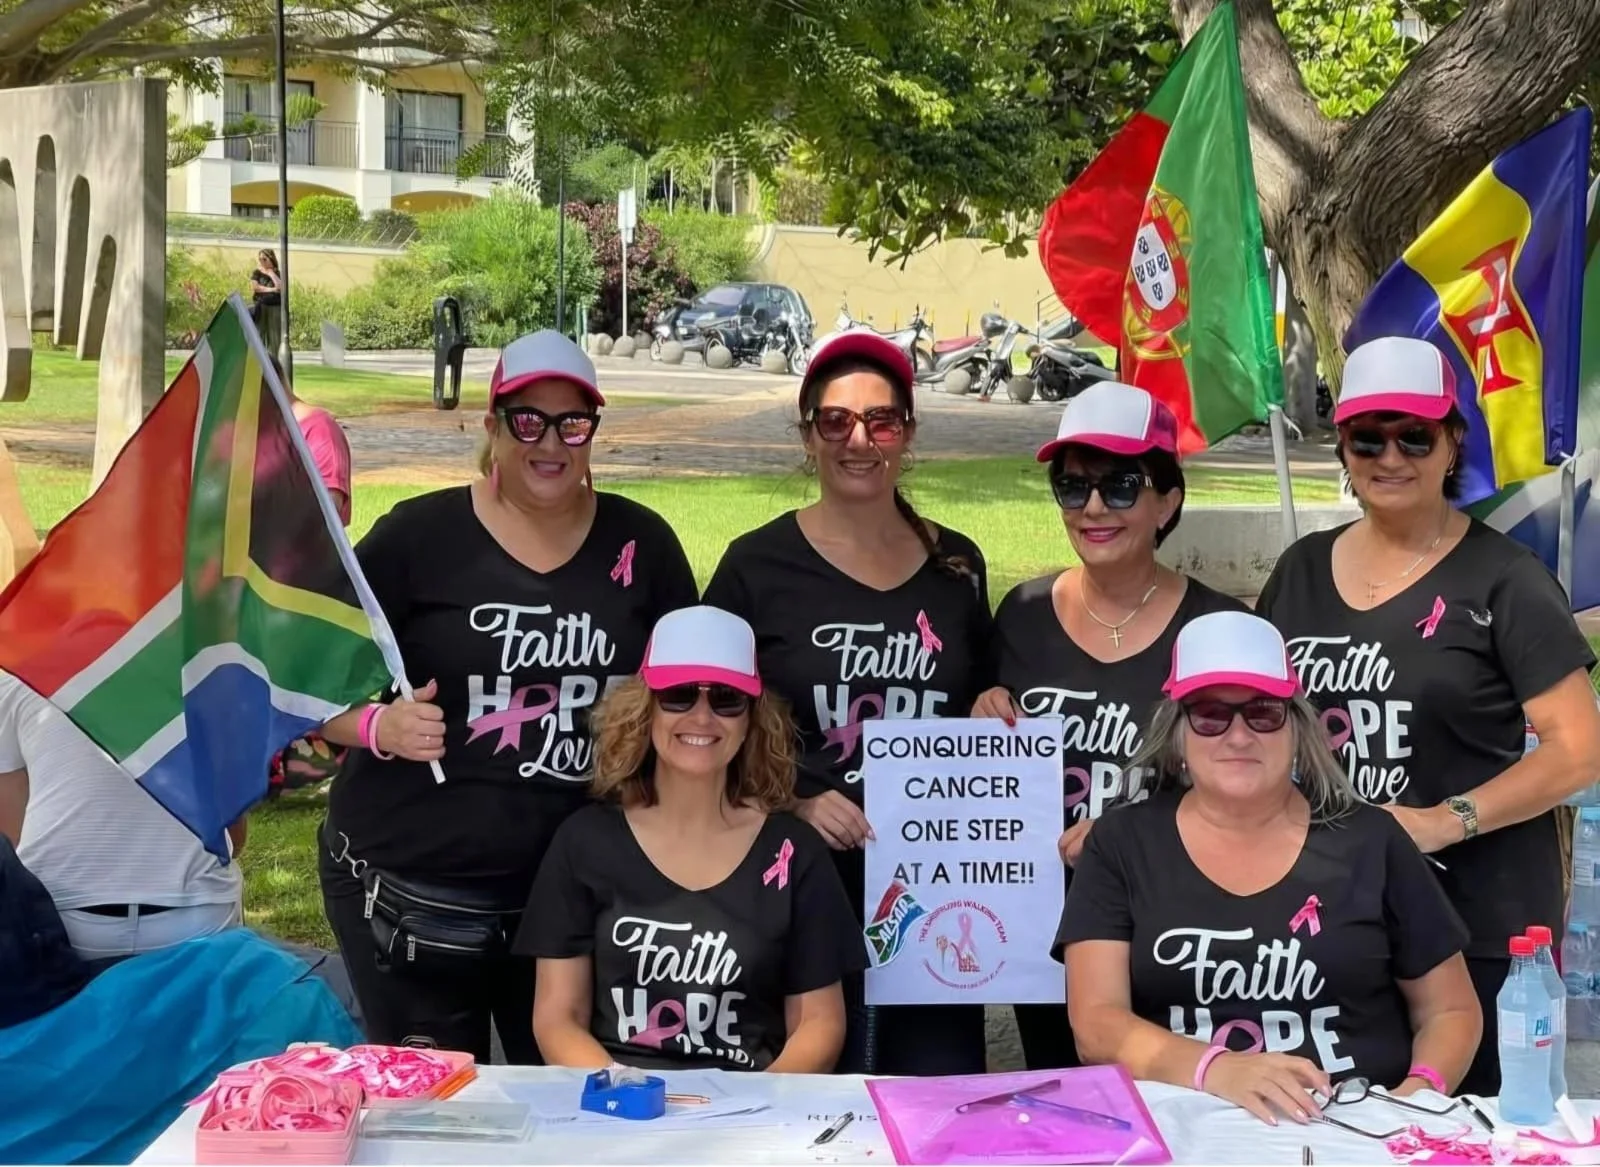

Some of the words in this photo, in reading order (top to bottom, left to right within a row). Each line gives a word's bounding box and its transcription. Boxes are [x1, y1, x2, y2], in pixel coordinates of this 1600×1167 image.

[469, 603, 616, 673] Faith
[811, 622, 936, 682] Faith
[1286, 636, 1395, 698] Faith
[518, 713, 597, 781] Lov
[867, 736, 1057, 759] CONQUERING
[1020, 687, 1144, 758] Faith
[904, 776, 1020, 799] CANCER
[902, 820, 959, 842] ONE
[967, 819, 1024, 841] STEP
[893, 863, 923, 885] AT
[931, 862, 951, 884] A
[959, 862, 1034, 884] TIME!!
[612, 916, 742, 986] Faith
[1153, 927, 1325, 1005] Faith
